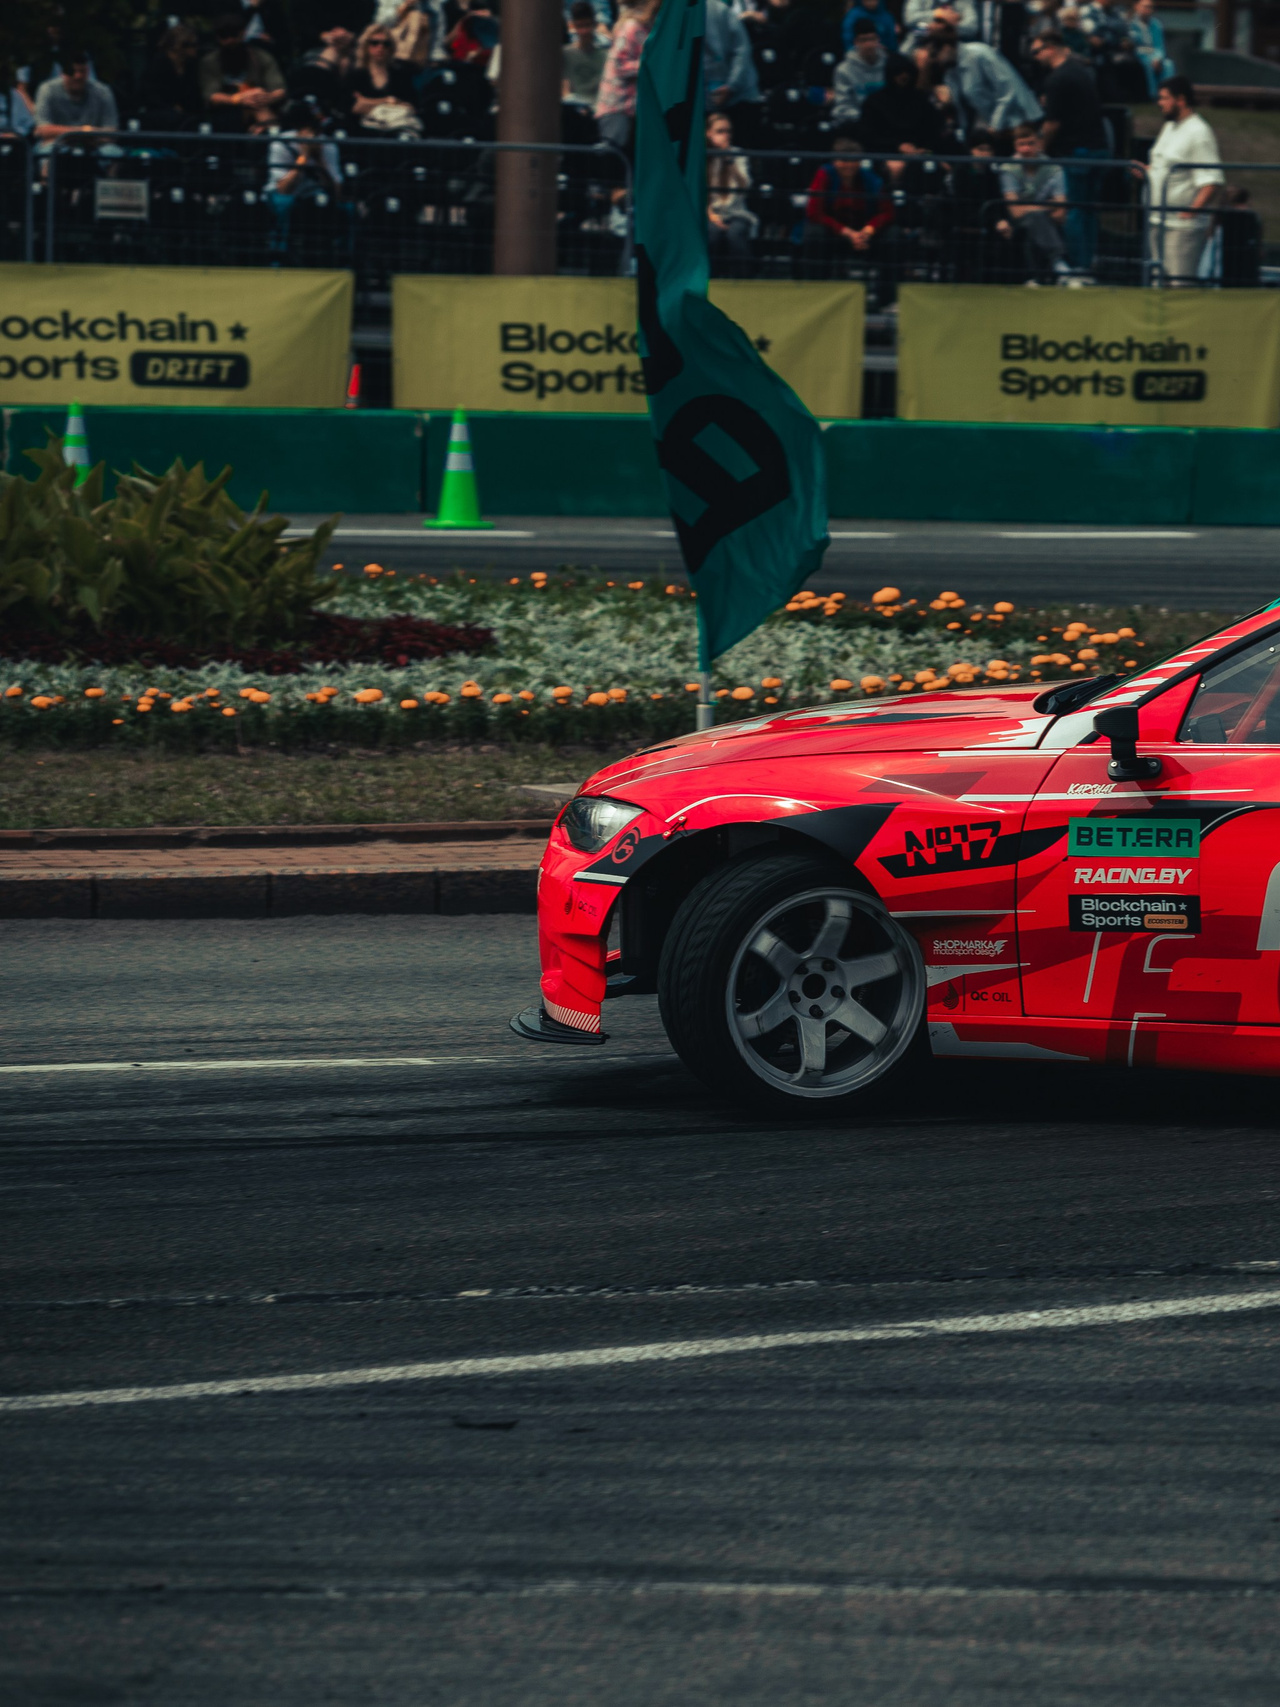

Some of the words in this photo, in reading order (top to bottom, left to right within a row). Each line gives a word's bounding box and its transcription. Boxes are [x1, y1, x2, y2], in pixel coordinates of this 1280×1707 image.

[0, 310, 218, 344] ockchain
[499, 322, 637, 355] Block
[1001, 334, 1192, 363] Blockchain
[0, 350, 120, 380] orts
[146, 358, 235, 383] DRIFT
[1000, 366, 1126, 401] Sports
[1076, 826, 1193, 848] BET.ERA
[1074, 868, 1192, 884] RACING.BY
[1081, 899, 1177, 912] Blockchain
[1081, 913, 1142, 928] Sports
[933, 940, 994, 949] SHOPMARKA
[970, 991, 988, 1001] QC
[992, 992, 1012, 1002] OIL
